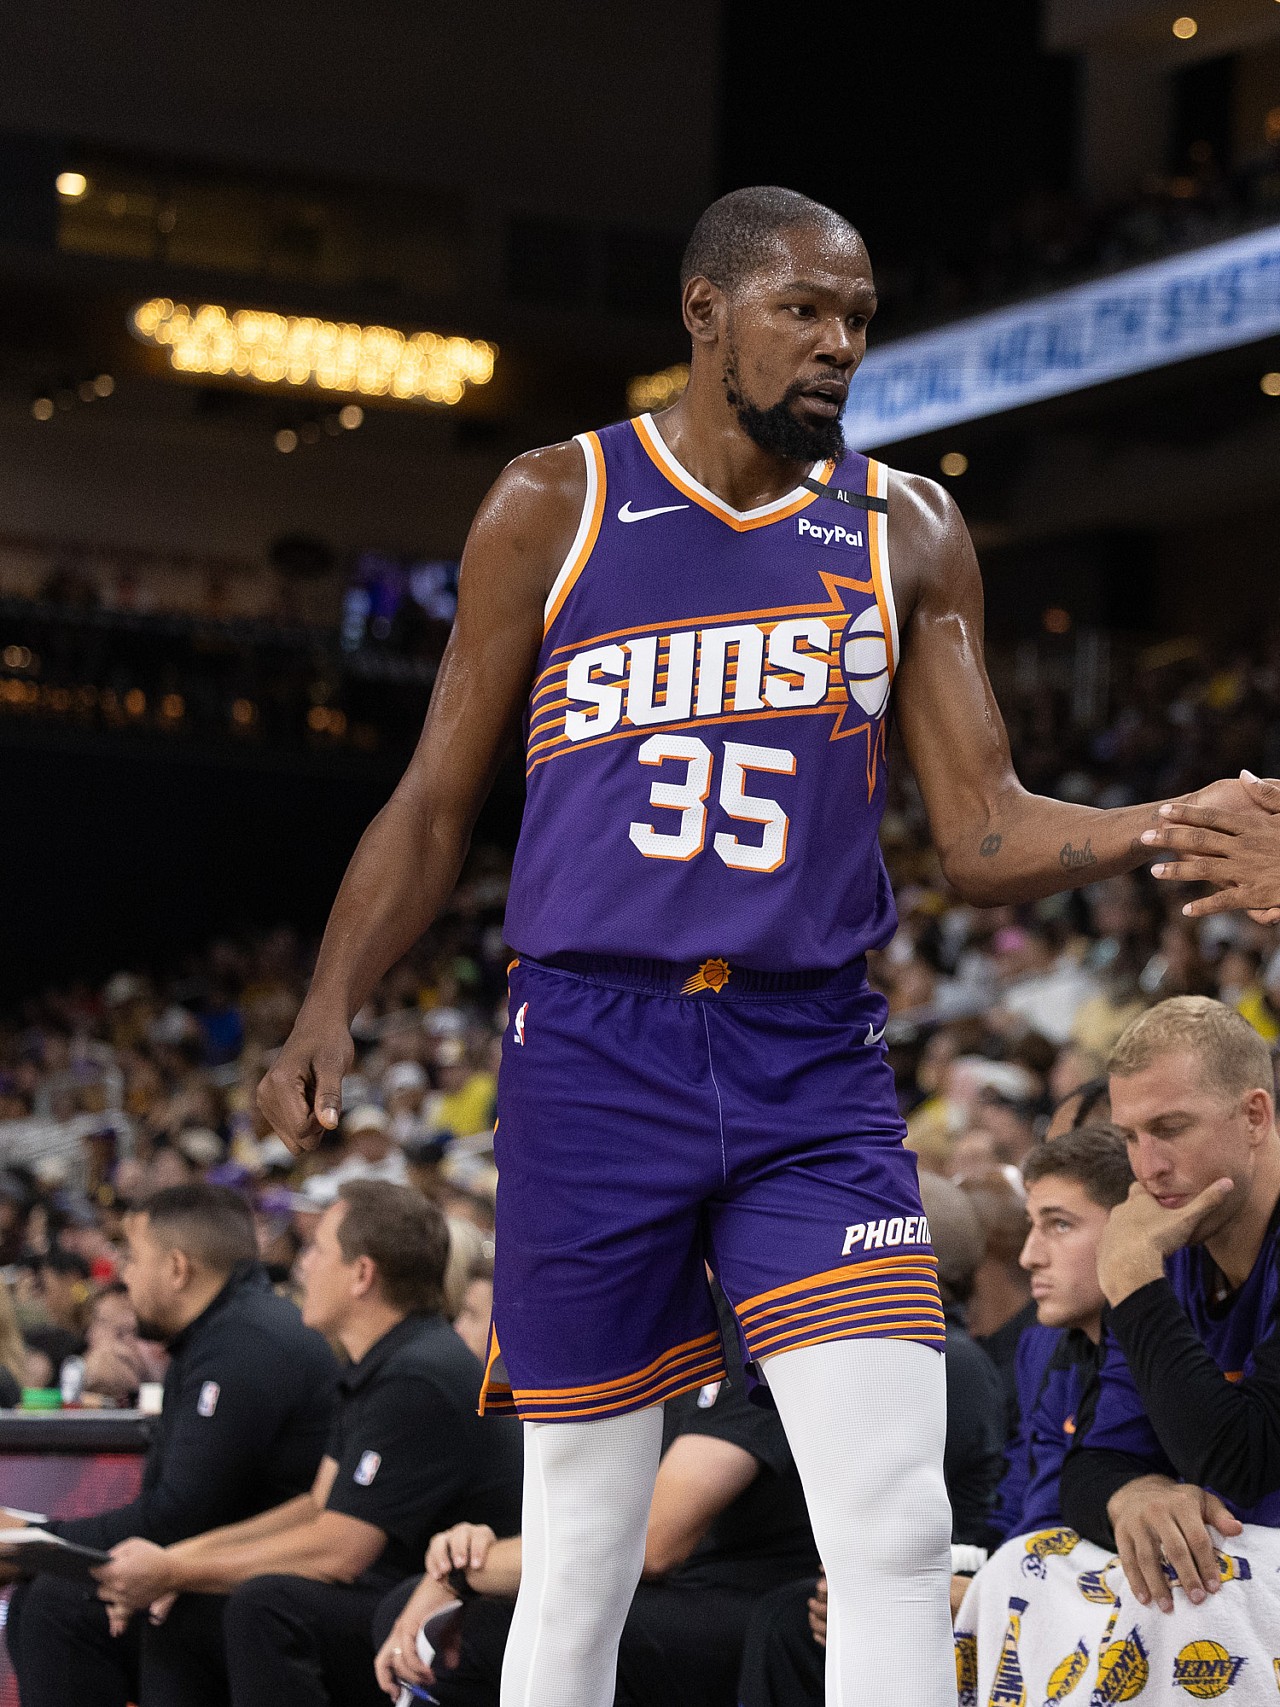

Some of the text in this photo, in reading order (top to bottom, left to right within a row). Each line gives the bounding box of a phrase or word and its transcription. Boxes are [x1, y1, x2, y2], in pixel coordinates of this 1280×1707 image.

[837, 488, 850, 503] AL
[798, 518, 863, 548] PayPal
[564, 619, 830, 743] SUNS
[629, 733, 796, 873] 35
[841, 1216, 932, 1257] PHOEN
[1172, 1656, 1248, 1686] LAKER
